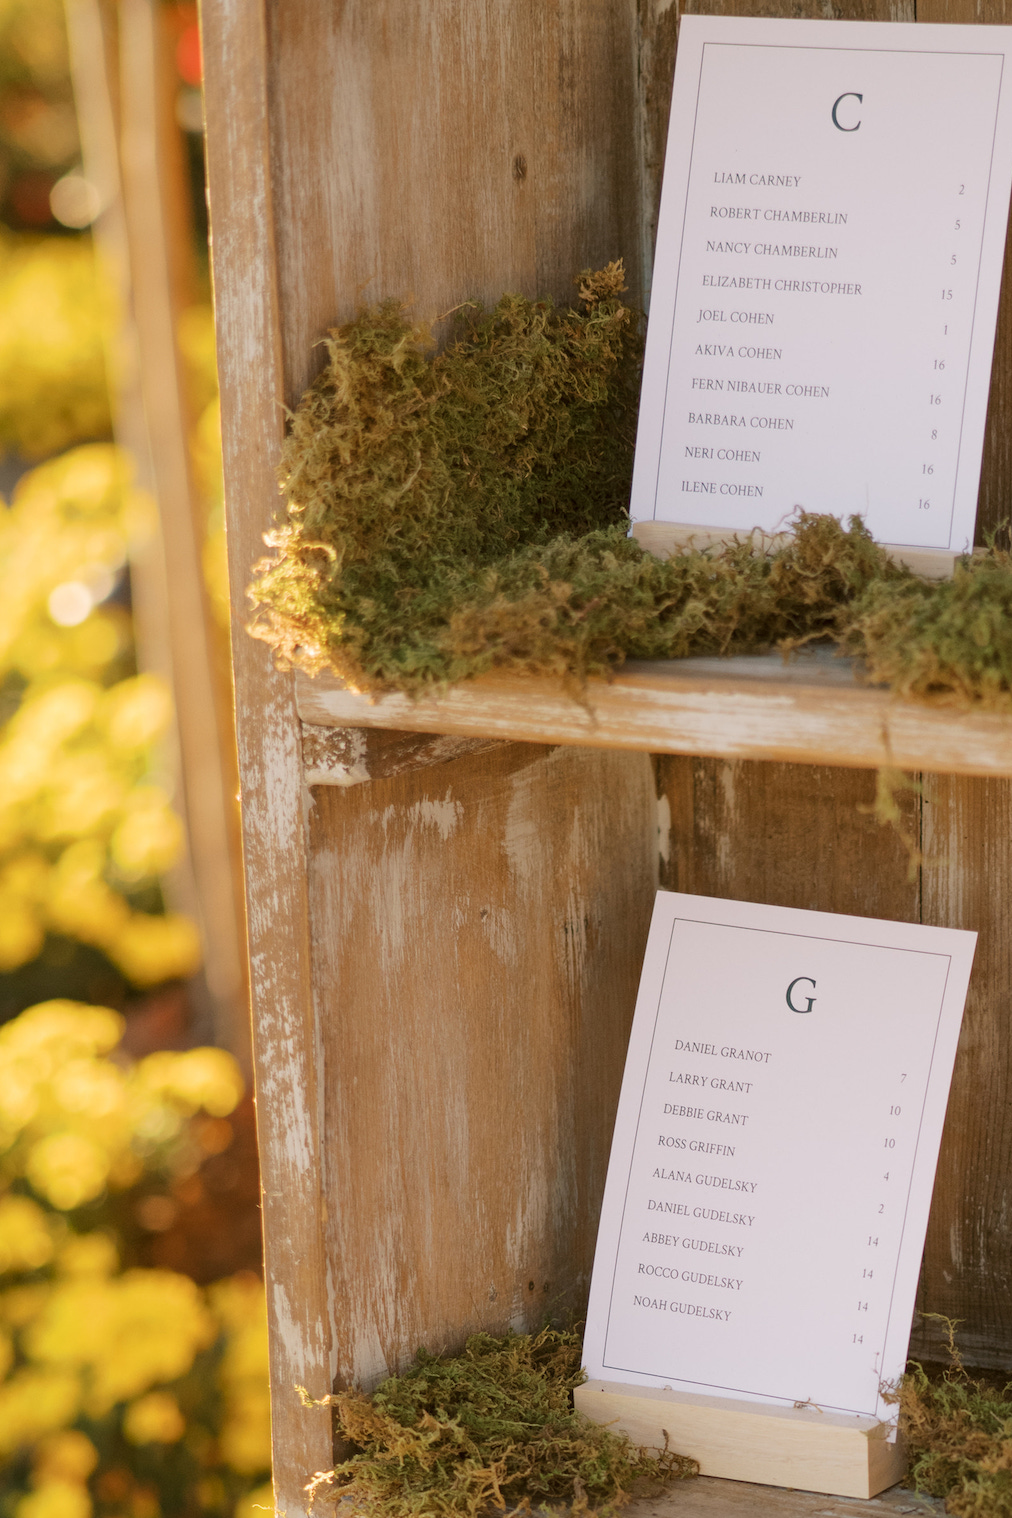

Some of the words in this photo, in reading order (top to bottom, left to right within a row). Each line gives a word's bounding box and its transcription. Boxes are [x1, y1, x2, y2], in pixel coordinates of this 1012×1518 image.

[831, 92, 863, 132] C
[714, 172, 746, 184] LIAM
[749, 174, 801, 187] CARNEY
[958, 184, 965, 195] 2
[710, 206, 761, 220] ROBERT
[763, 209, 848, 224] CHAMBERLIN
[954, 219, 961, 230] 5
[706, 240, 751, 254] NANCY
[754, 243, 838, 258] CHAMBERLIN
[950, 254, 957, 265] 5
[702, 275, 771, 290] ELIZABETH
[774, 279, 862, 295] CHRISTOPHER
[941, 289, 953, 300] 15
[696, 309, 727, 323] JOEL
[730, 311, 774, 324] COHEN
[695, 344, 734, 357] AKIVA
[738, 346, 782, 359] COHEN
[934, 359, 945, 370] 16
[692, 378, 724, 390] FERN
[727, 380, 782, 395] NIBAUER
[785, 384, 829, 397] COHEN
[930, 394, 941, 405] 16
[688, 412, 746, 427] BARBARA
[750, 417, 794, 430] COHEN
[931, 429, 938, 440] 8
[685, 446, 714, 459] NERI
[717, 449, 761, 462] COHEN
[922, 464, 934, 475] 16
[682, 480, 717, 494] ILENE
[719, 483, 763, 497] COHEN
[919, 499, 930, 510] 16
[786, 976, 817, 1014] G
[675, 1039, 718, 1056] DANIEL
[720, 1047, 772, 1063] GRANOT
[901, 1073, 907, 1083] 7
[669, 1071, 708, 1087] LARRY
[710, 1078, 753, 1093] GRANT
[890, 1105, 901, 1116] 10
[663, 1103, 704, 1119] DEBBIE
[706, 1110, 749, 1126] GRANT
[884, 1138, 896, 1149] 10
[658, 1135, 687, 1149] ROSS
[689, 1140, 735, 1156] GRIFFIN
[883, 1172, 889, 1181] 4
[652, 1168, 692, 1183] ALANA
[695, 1174, 758, 1193] GUDELSKY
[878, 1203, 885, 1214] 2
[647, 1199, 690, 1216] DANIEL
[693, 1207, 755, 1226] GUDELSKY
[868, 1236, 879, 1247] 14
[642, 1232, 680, 1247] ABBEY
[682, 1238, 744, 1257] GUDELSKY
[862, 1268, 873, 1279] 14
[638, 1263, 679, 1279] ROCCO
[681, 1271, 743, 1290] GUDELSKY
[857, 1301, 868, 1312] 14
[633, 1295, 667, 1311] NOAH
[670, 1302, 732, 1321] GUDELSKY
[853, 1333, 863, 1344] 14
